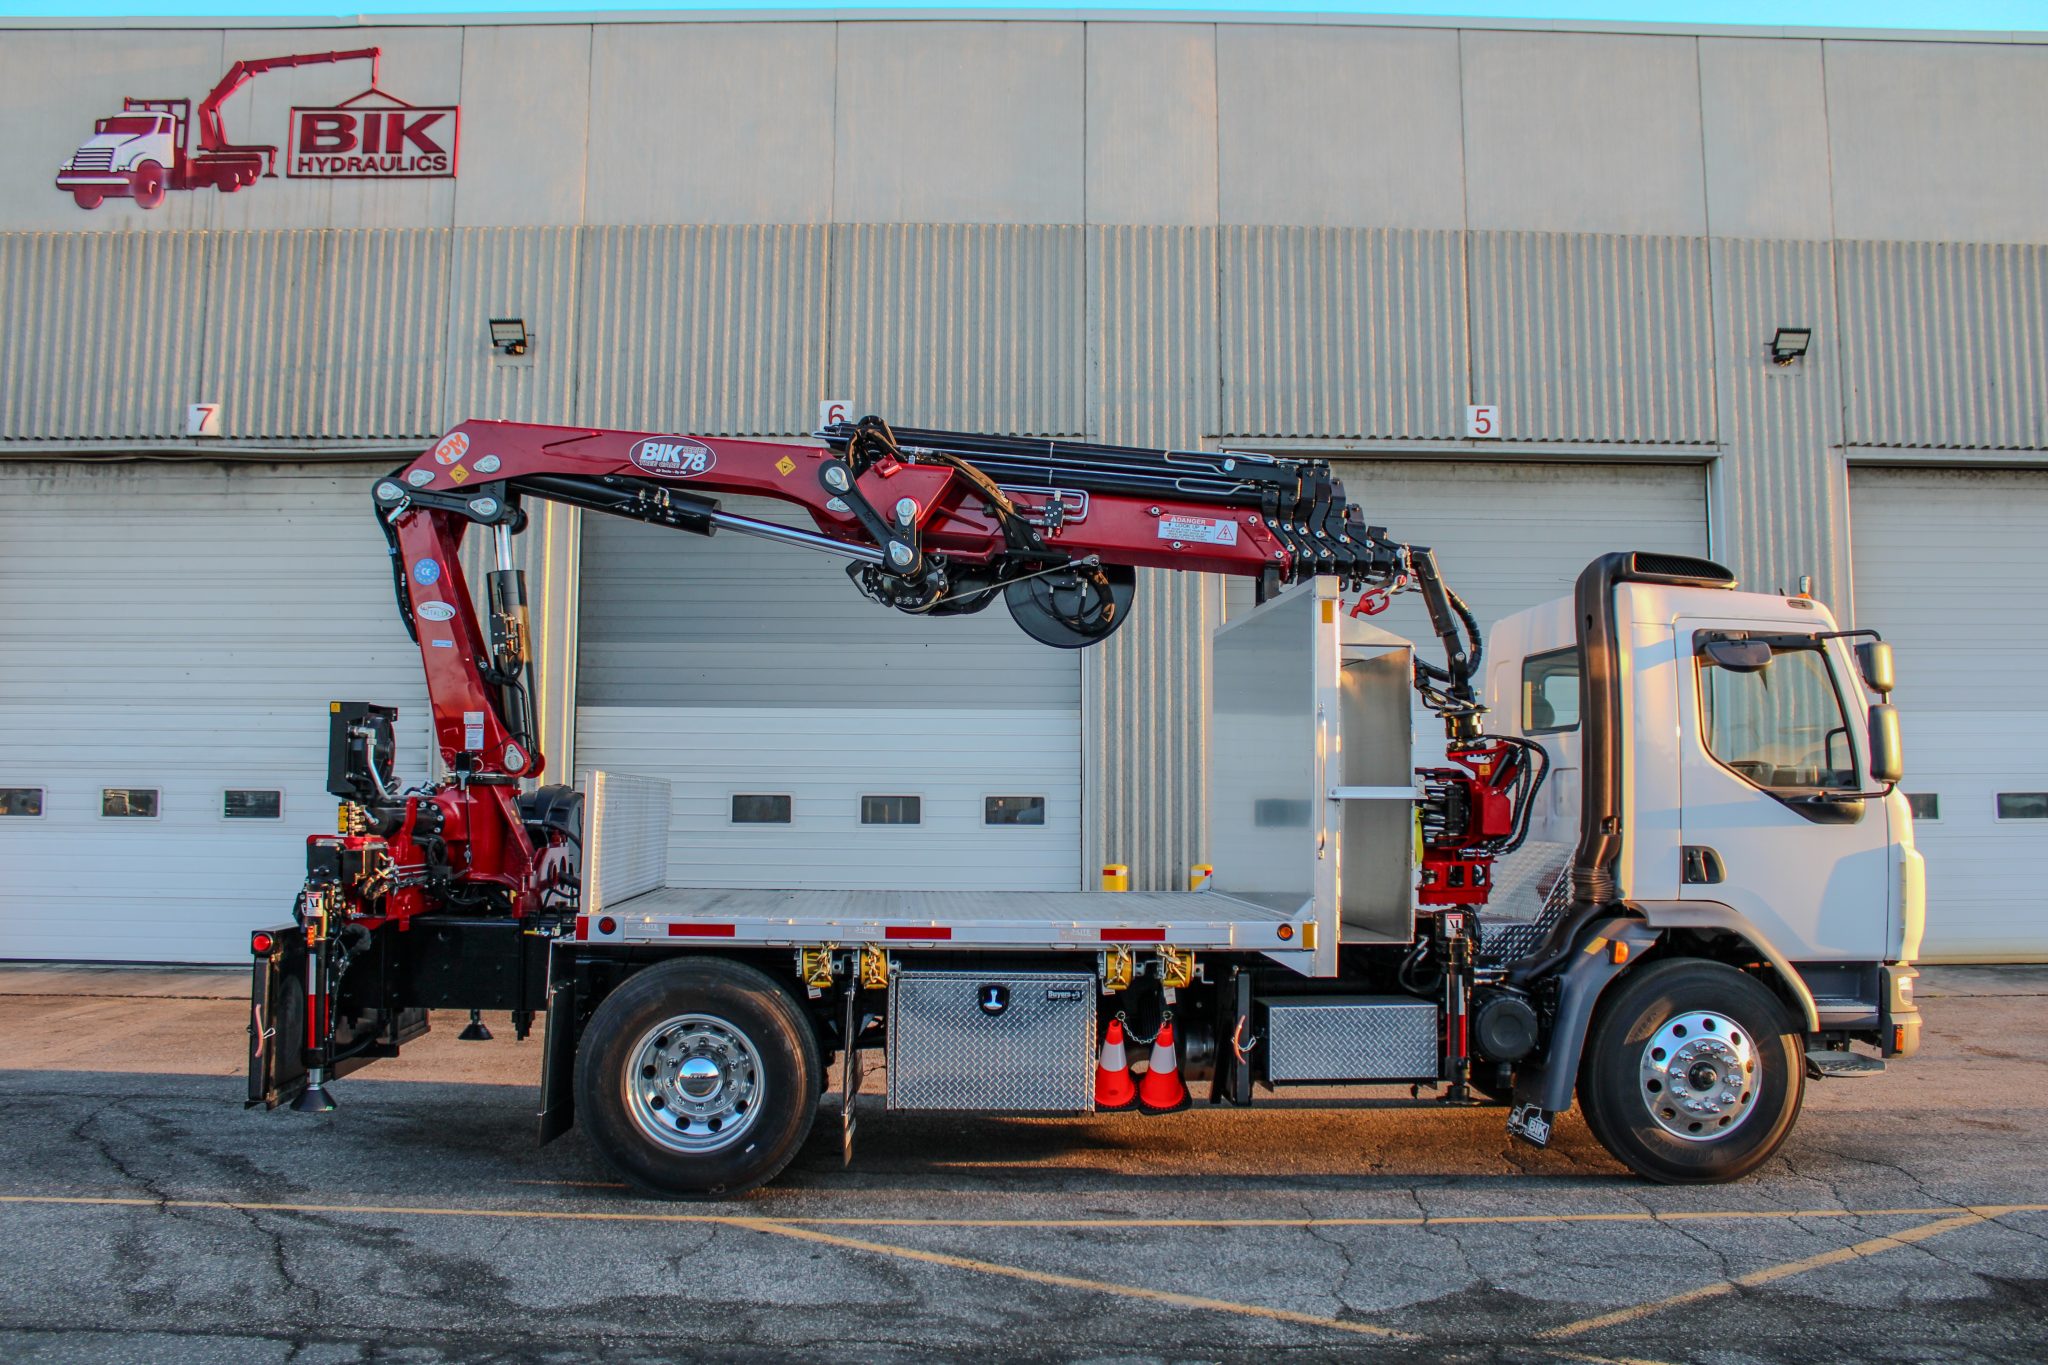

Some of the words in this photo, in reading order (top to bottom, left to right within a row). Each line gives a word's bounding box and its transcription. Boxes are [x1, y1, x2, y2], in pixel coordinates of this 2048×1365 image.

[299, 113, 446, 154] BIK
[298, 156, 447, 172] HYDRAULICS
[196, 407, 213, 432] 7
[828, 404, 845, 425] 6
[1475, 409, 1491, 434] 5
[437, 433, 468, 463] PM
[640, 442, 683, 463] BIK
[680, 453, 707, 471] 78
[1176, 517, 1206, 525] DANGER
[1047, 990, 1071, 999] Buyers
[1529, 1119, 1547, 1140] BIK
